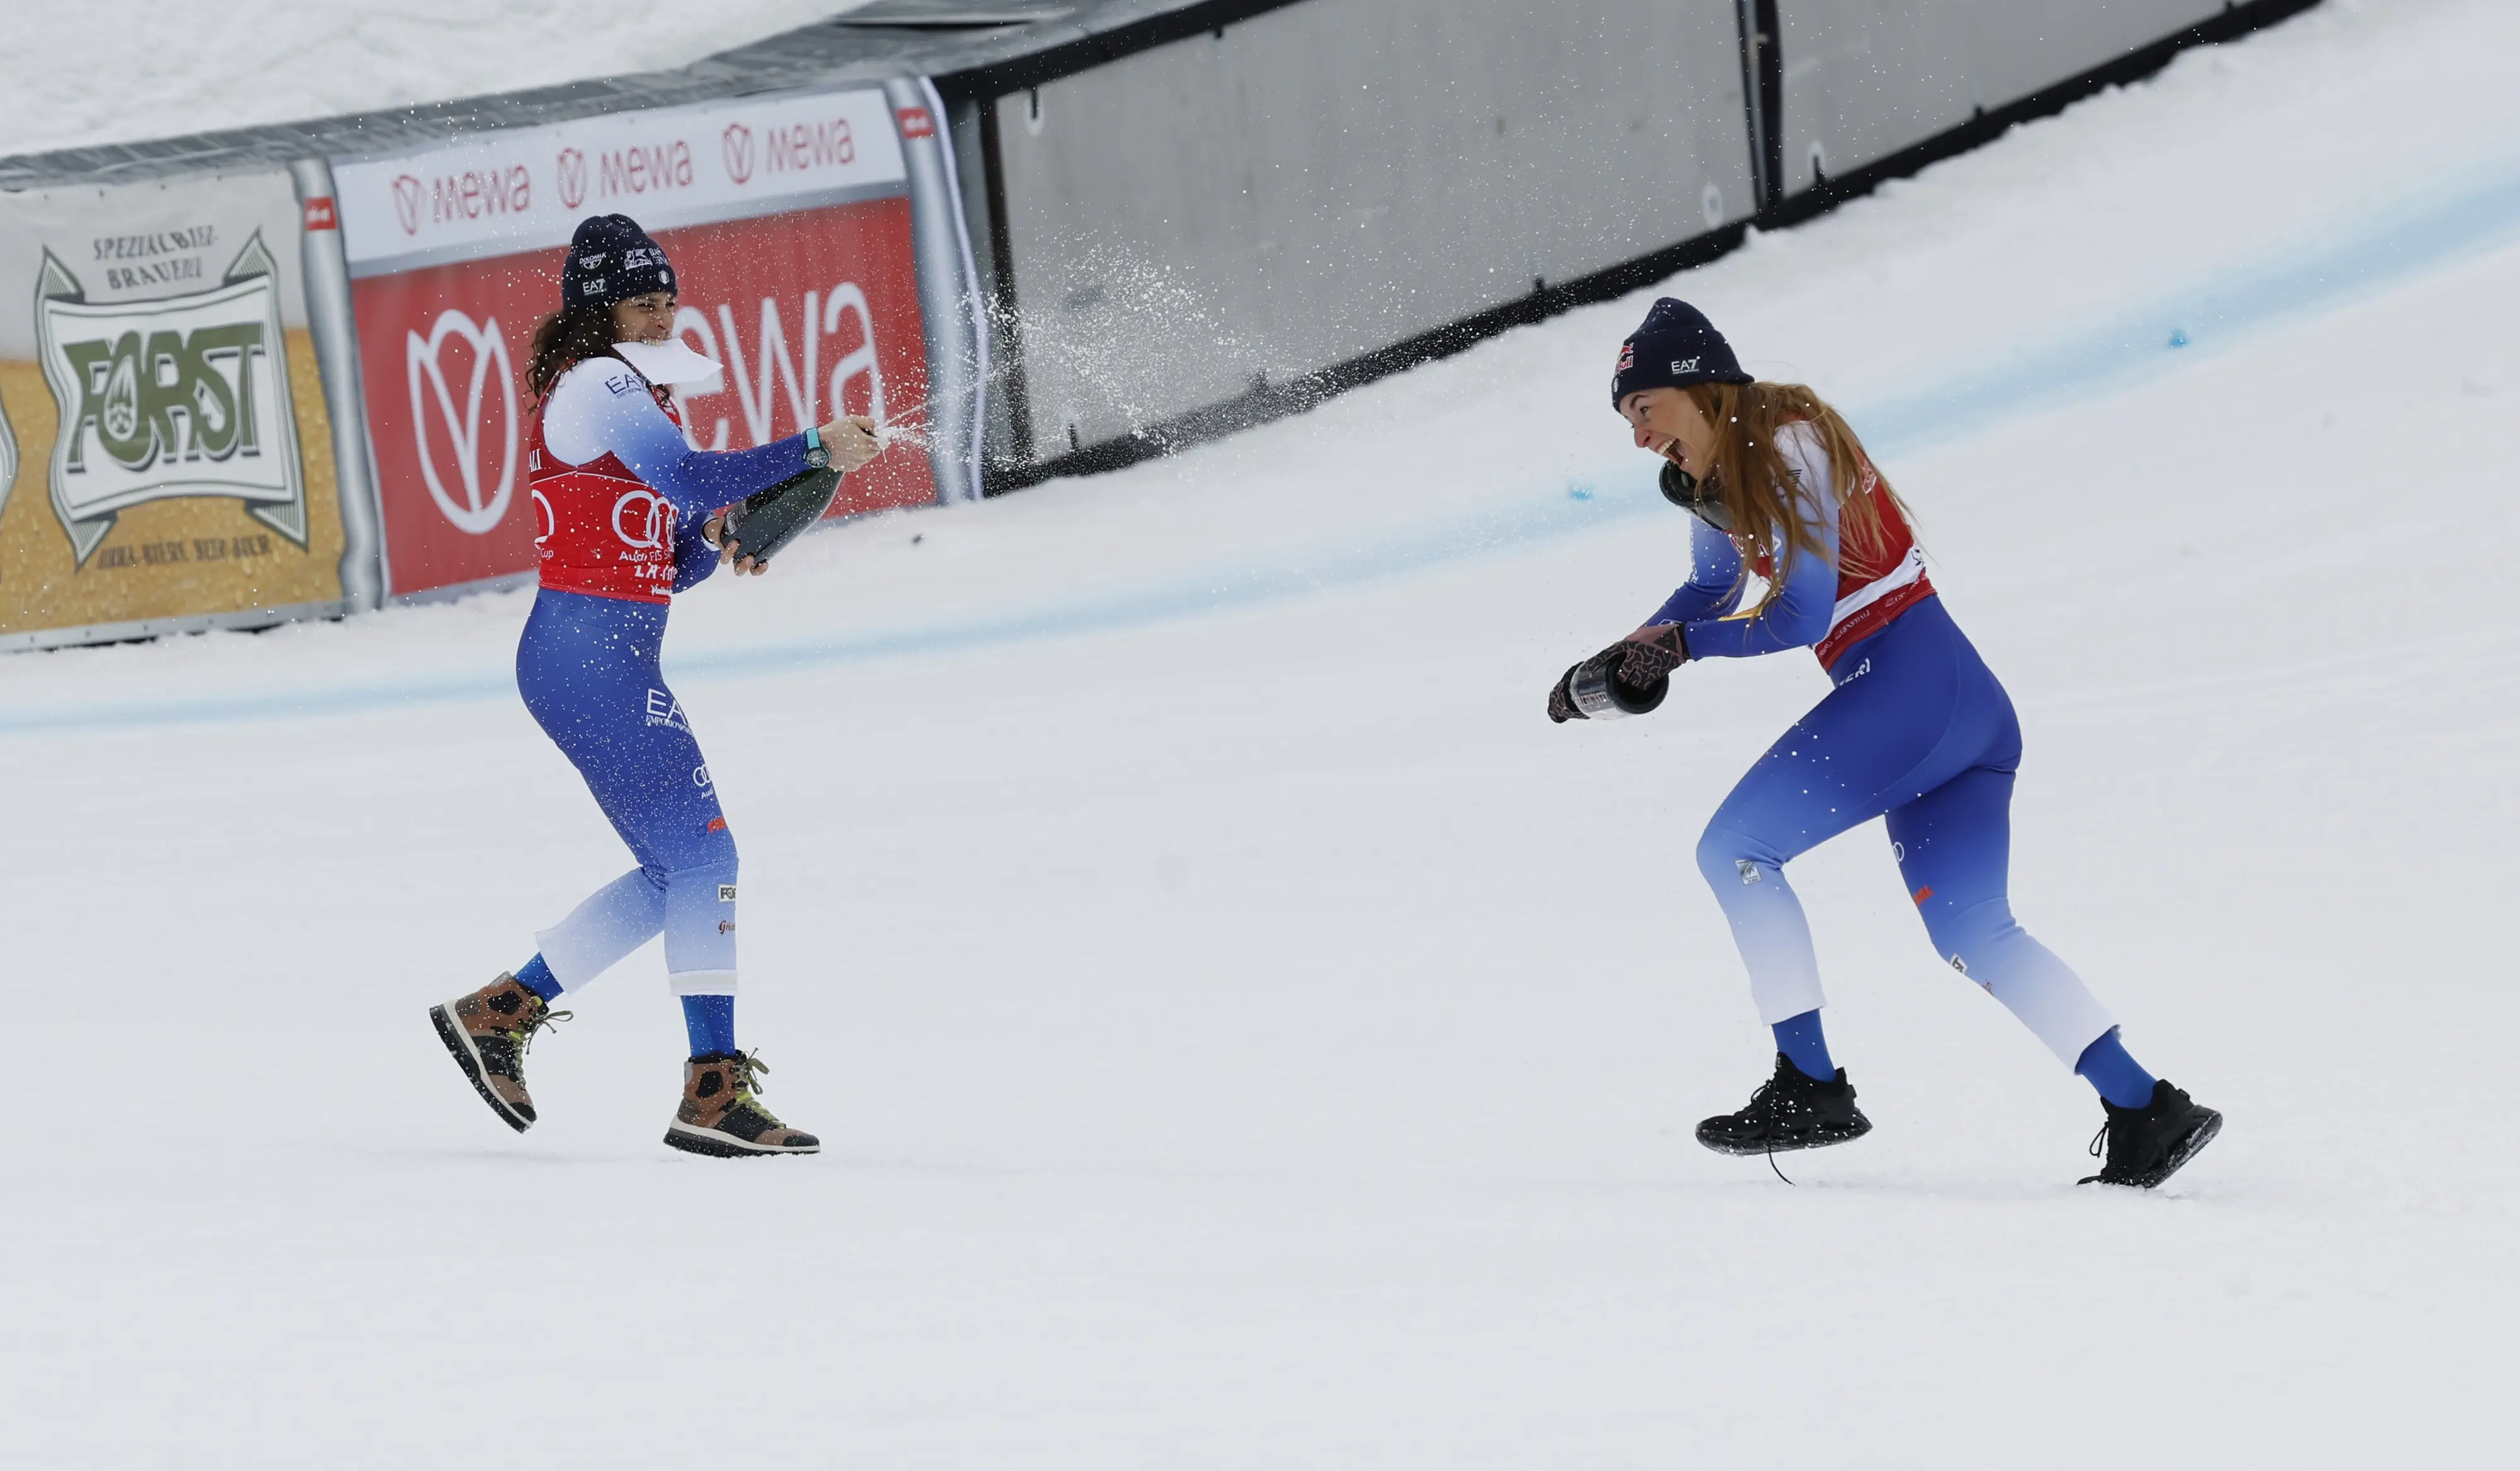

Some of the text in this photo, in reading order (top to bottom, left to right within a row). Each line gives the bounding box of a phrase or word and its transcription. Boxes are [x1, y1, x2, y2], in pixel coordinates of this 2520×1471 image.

[580, 252, 607, 265] DOLOMIA
[583, 278, 605, 292] EA7
[673, 282, 886, 452] ewa
[1671, 359, 1697, 372] EA7
[62, 321, 266, 474] FORST
[541, 547, 554, 559] Cup
[619, 551, 648, 562] Audi
[649, 550, 663, 561] FIS
[634, 564, 658, 579] LA
